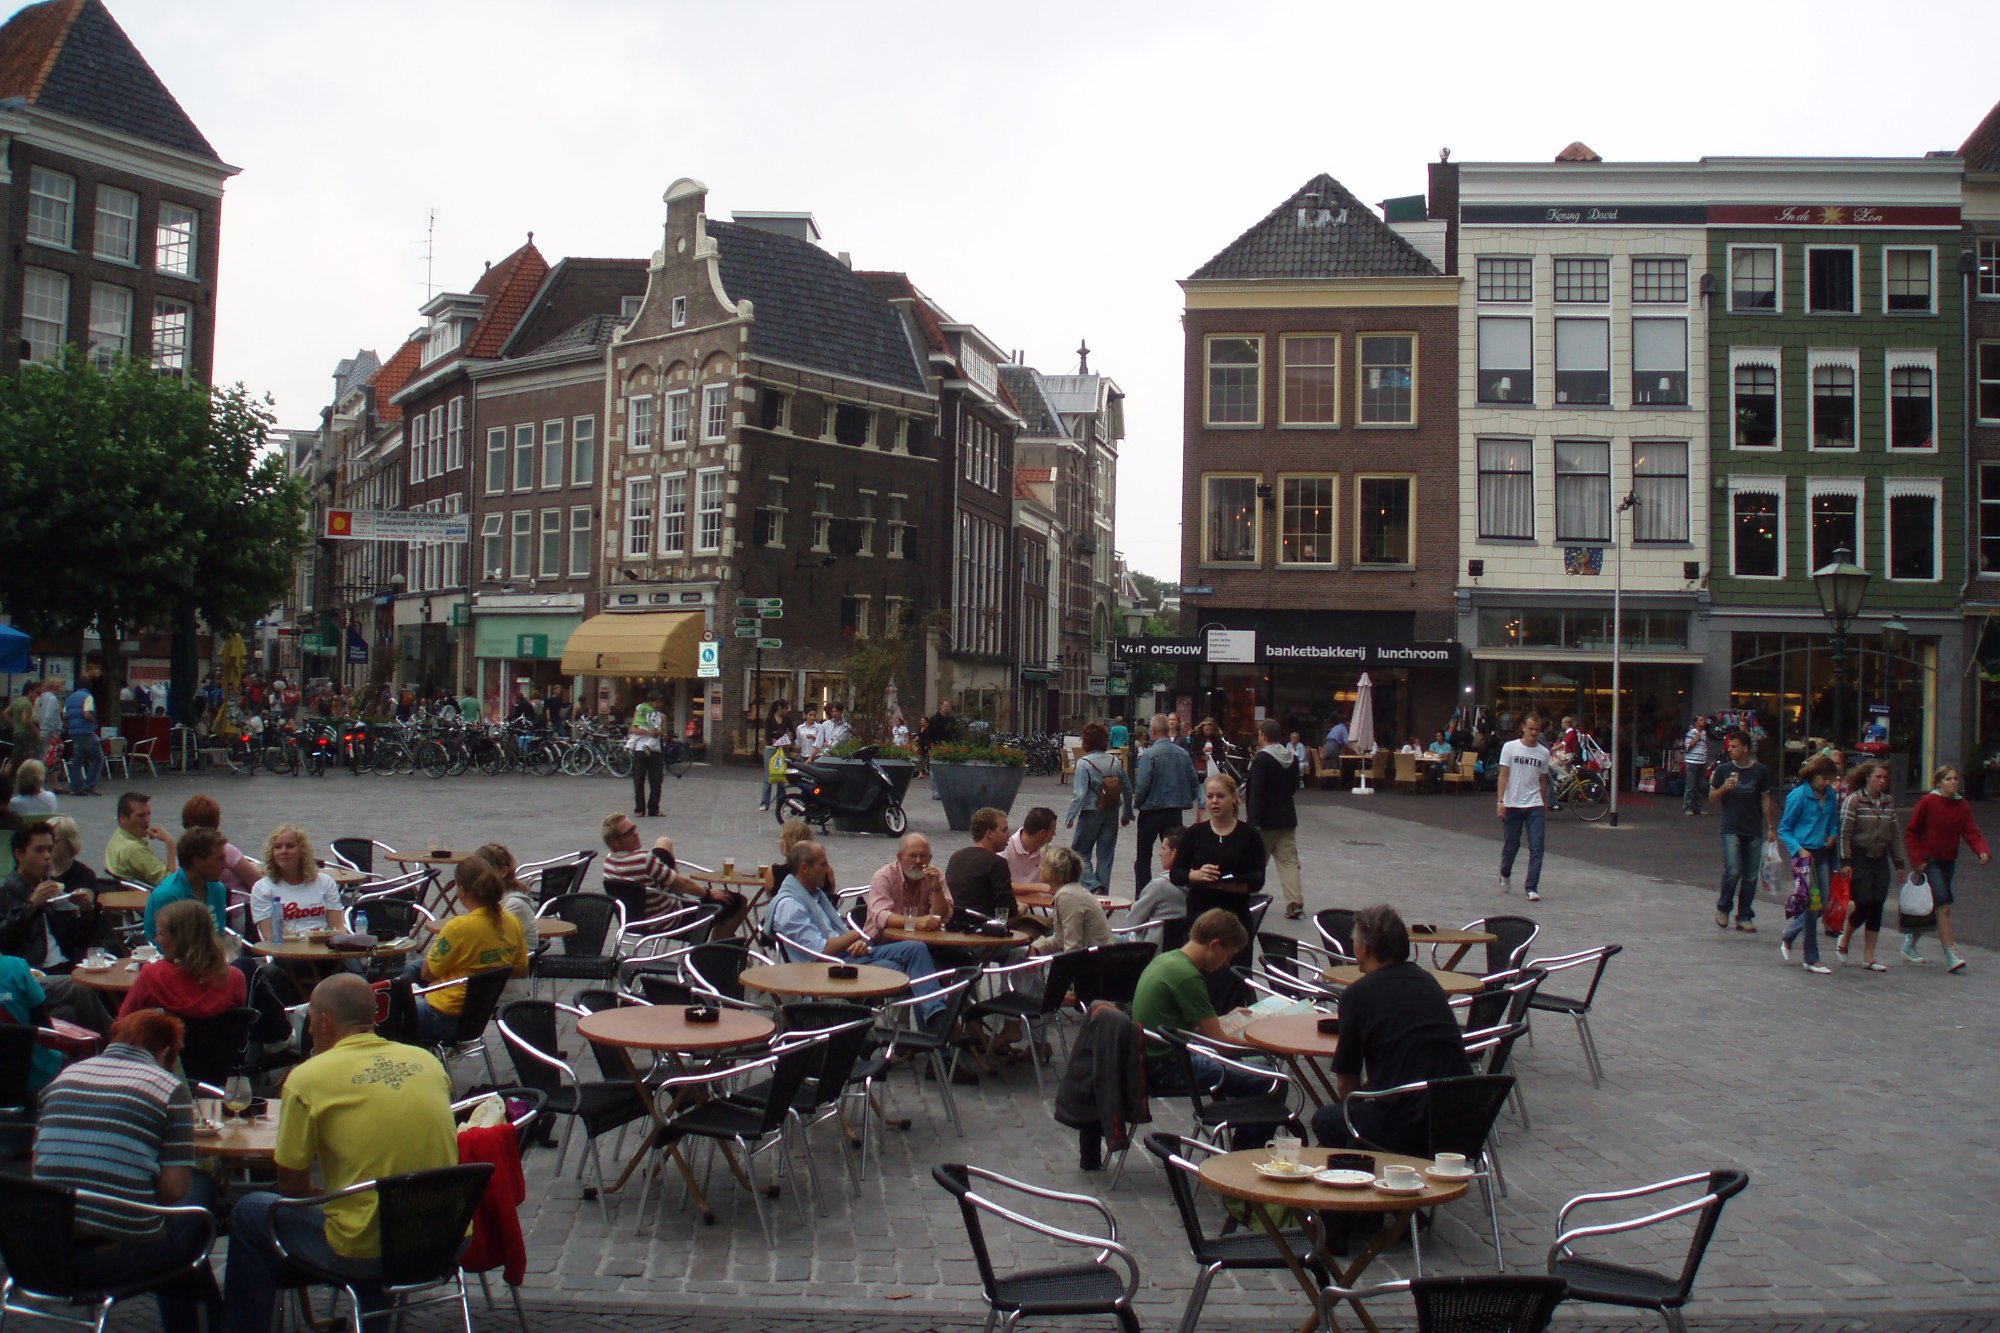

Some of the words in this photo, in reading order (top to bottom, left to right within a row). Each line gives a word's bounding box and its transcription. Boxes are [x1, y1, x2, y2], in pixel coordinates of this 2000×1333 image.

[1545, 208, 1580, 224] Koning
[1586, 207, 1618, 220] David
[1853, 207, 1883, 222] Zon
[376, 519, 416, 527] Infoavond
[418, 520, 467, 528] Celecentrum
[1121, 644, 1146, 654] van
[1150, 645, 1202, 655] orsouw
[1266, 644, 1367, 661] banketbakkerij
[1377, 647, 1449, 660] lunchroom
